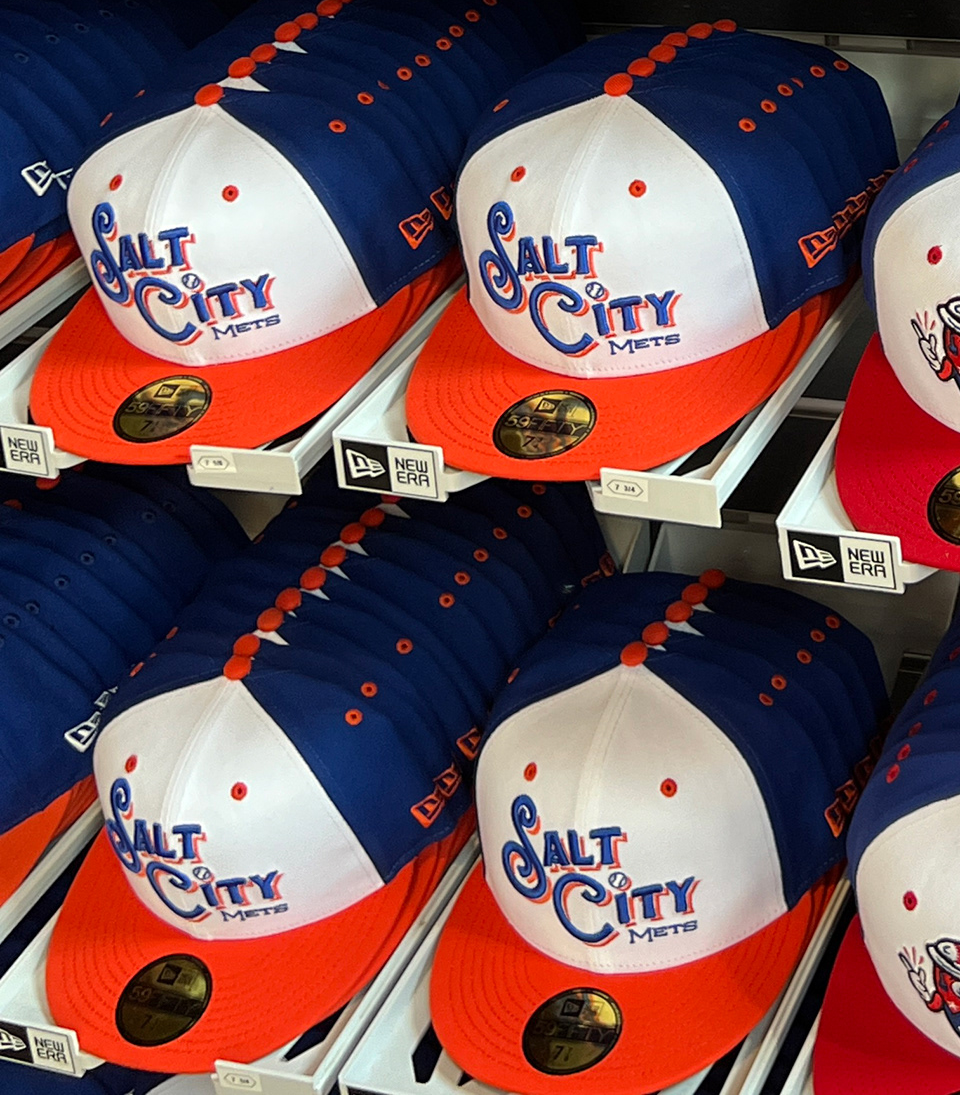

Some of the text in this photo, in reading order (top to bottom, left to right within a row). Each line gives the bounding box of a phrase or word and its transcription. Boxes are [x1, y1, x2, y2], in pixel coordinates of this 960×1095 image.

[8, 437, 38, 452] NEW
[10, 449, 40, 465] ERA
[395, 457, 428, 473] NEW
[397, 471, 430, 487] ERA
[847, 547, 884, 563] NEW
[850, 562, 887, 578] ERA
